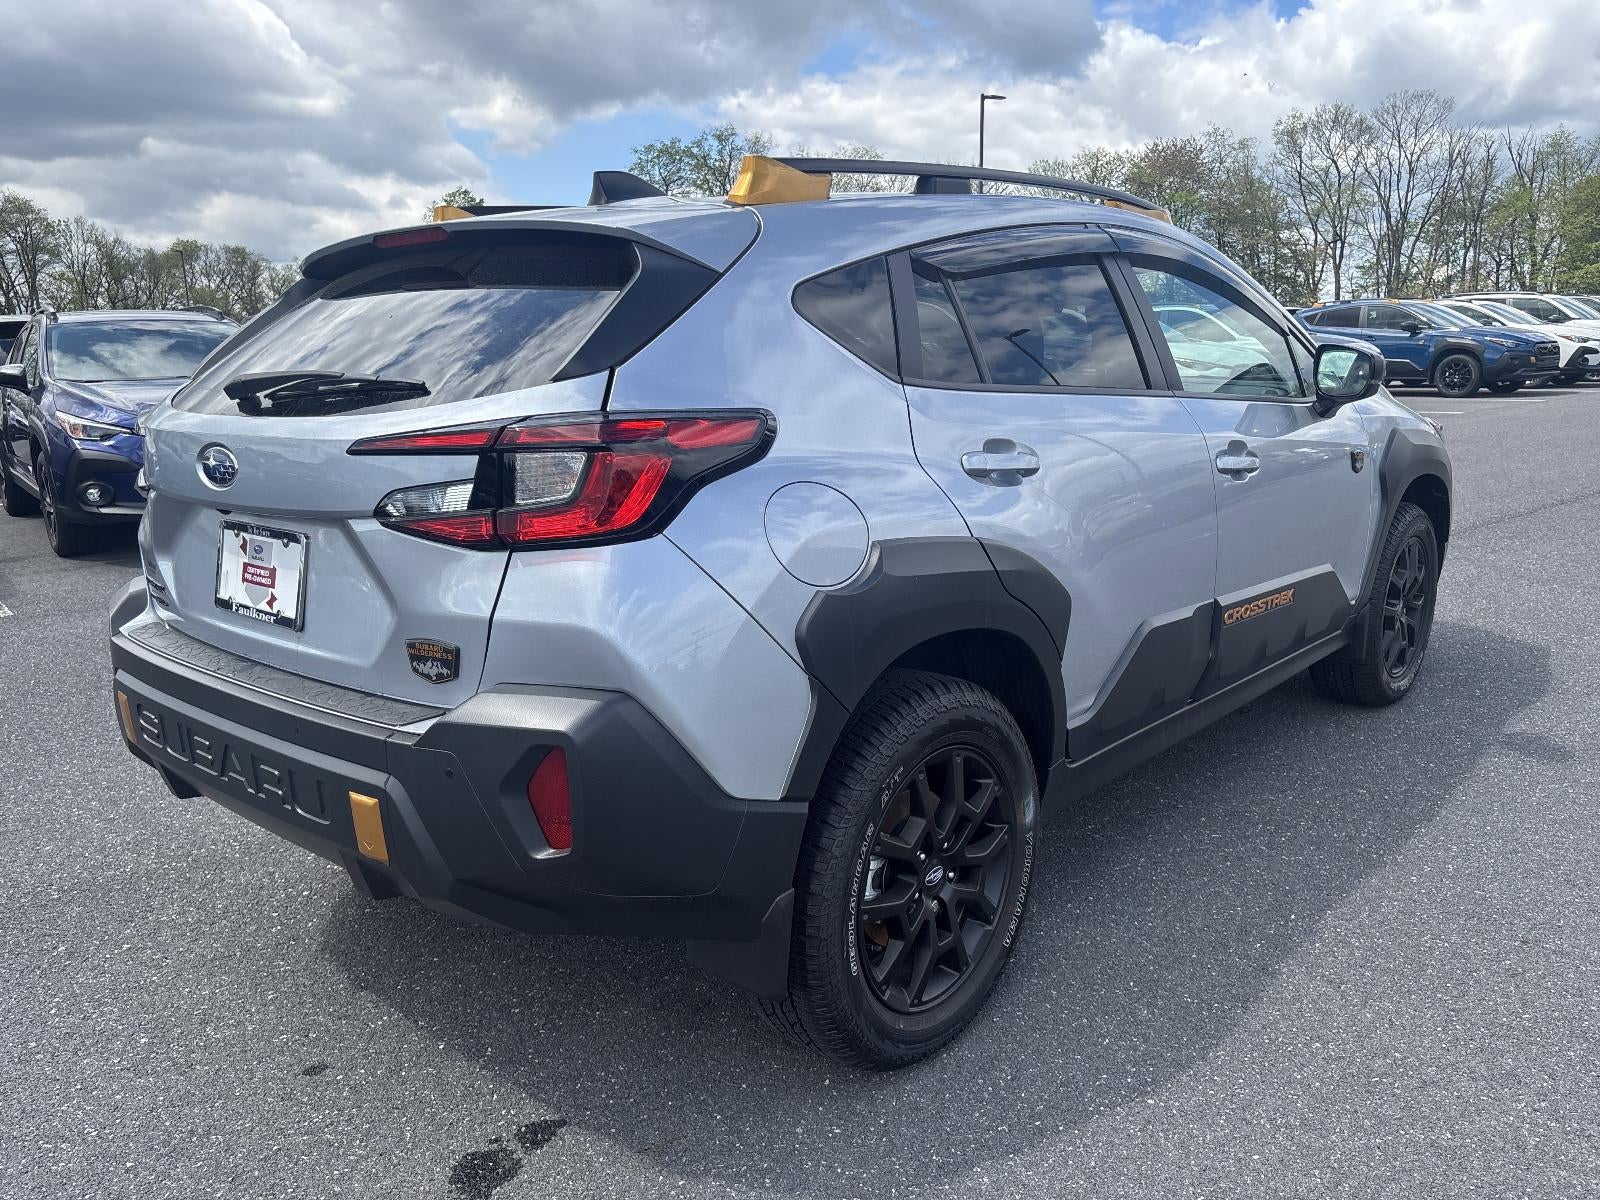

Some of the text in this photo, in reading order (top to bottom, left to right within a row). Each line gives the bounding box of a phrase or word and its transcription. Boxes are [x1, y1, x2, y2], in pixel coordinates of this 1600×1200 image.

[247, 566, 270, 576] CERTIFIED
[244, 573, 272, 585] PRE-OWNED
[232, 602, 277, 623] Faulkner
[1224, 588, 1295, 625] CROSSTREK
[406, 647, 453, 660] WILDERNESS
[415, 642, 444, 653] SUBARU
[136, 703, 331, 825] SUBARU
